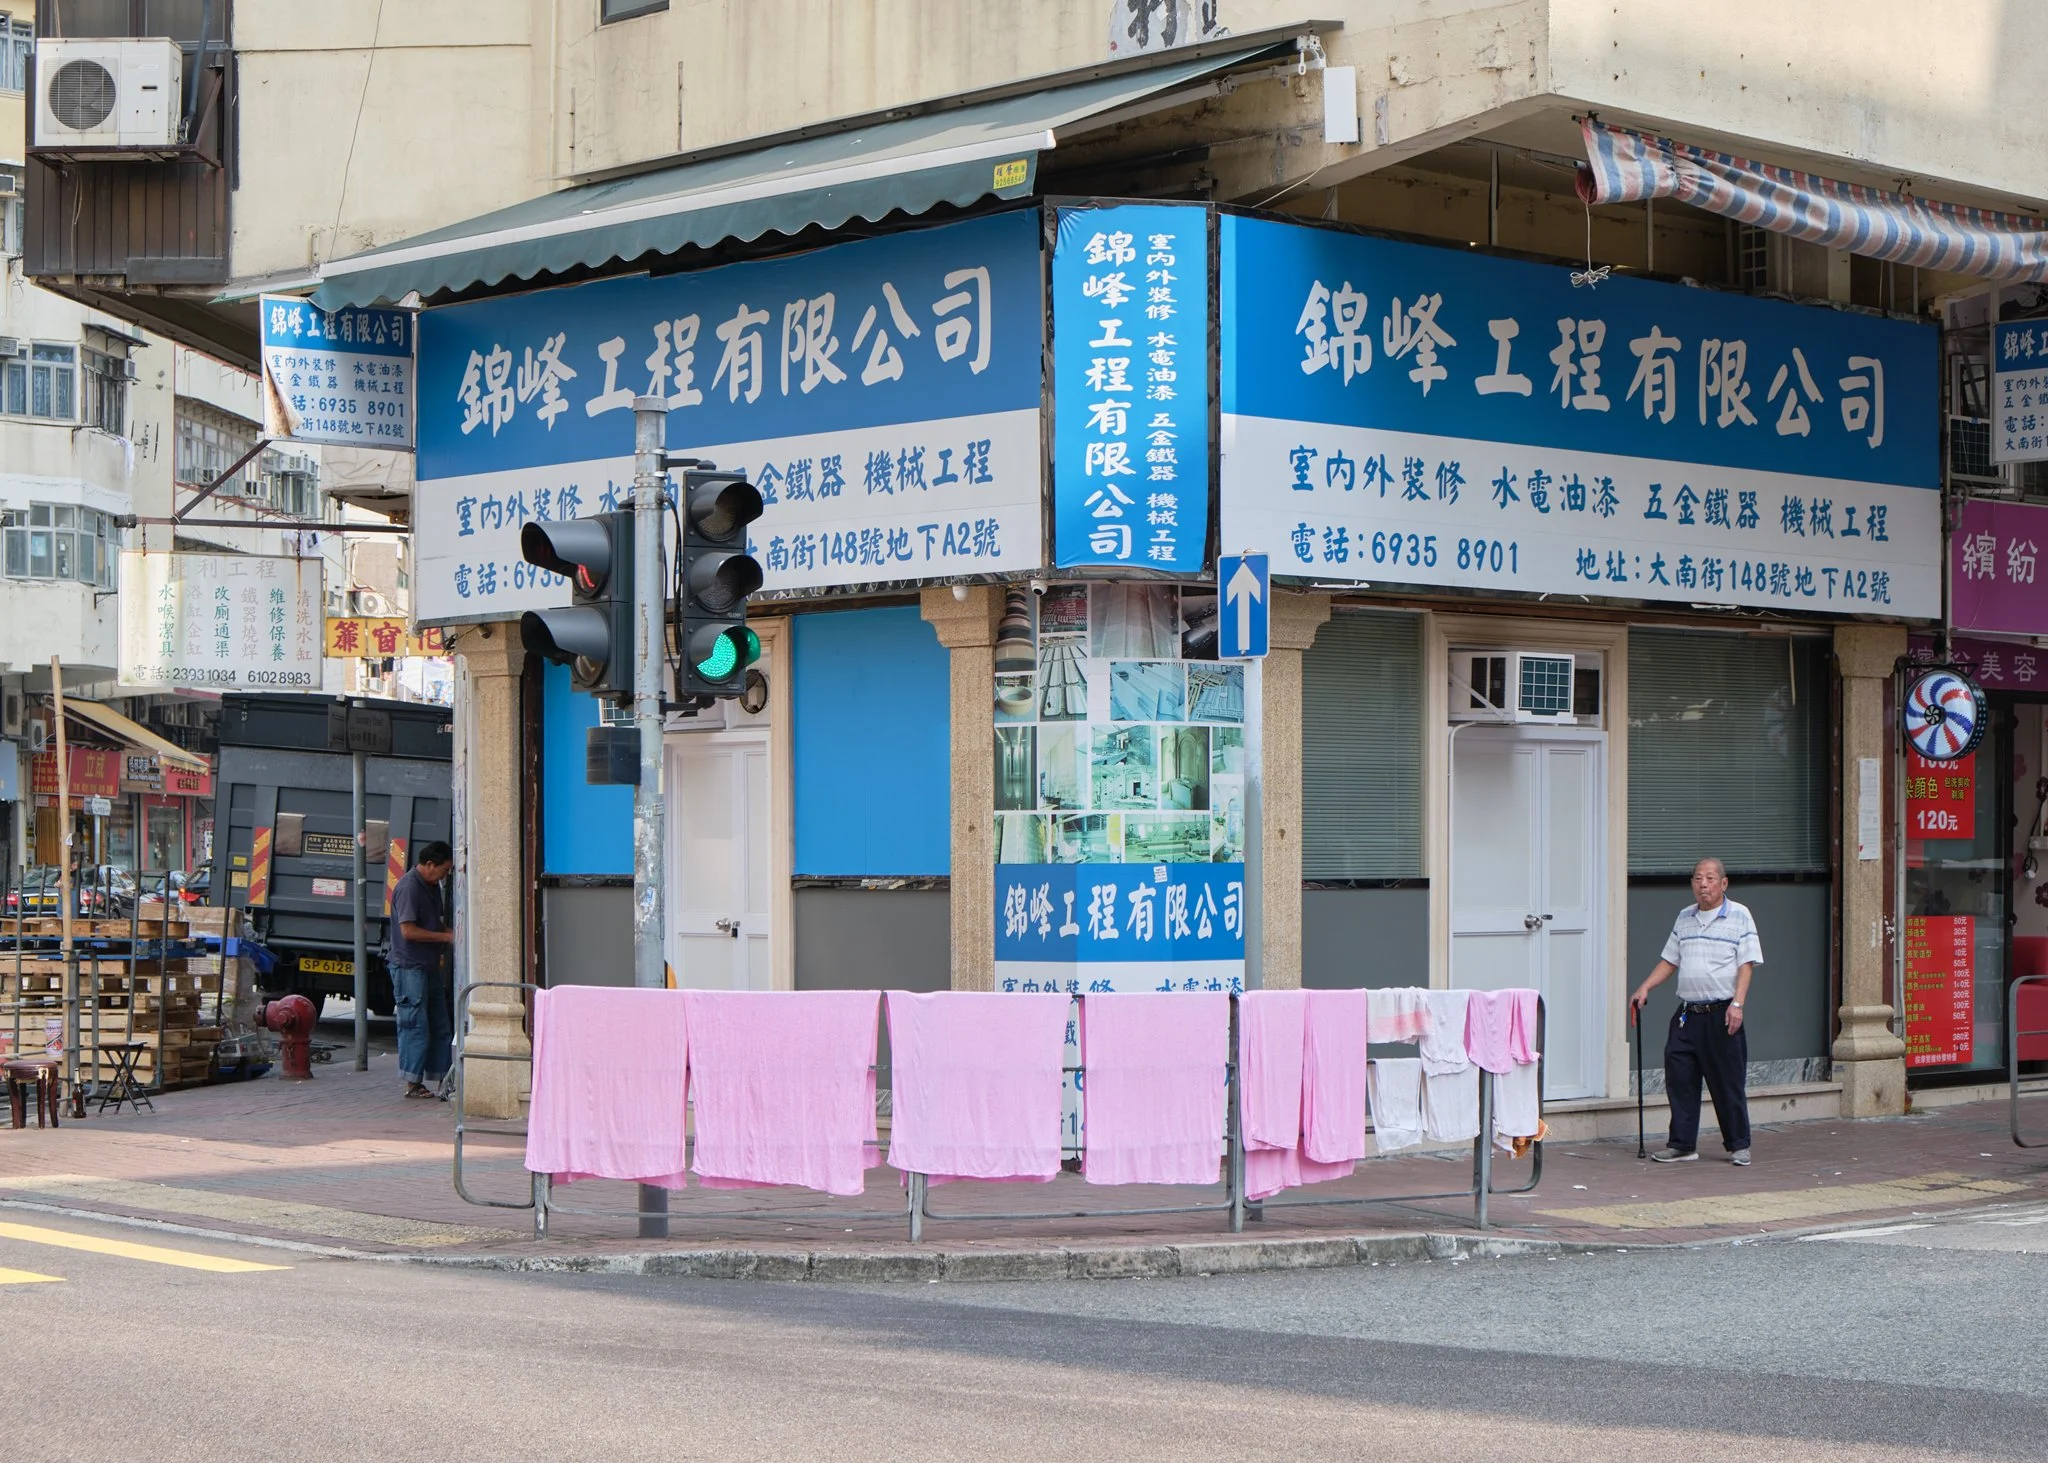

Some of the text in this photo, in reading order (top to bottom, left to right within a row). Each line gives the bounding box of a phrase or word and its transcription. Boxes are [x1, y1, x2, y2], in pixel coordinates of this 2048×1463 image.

[270, 304, 405, 347] 錦峰工程有限公司
[457, 266, 991, 438] 錦峰工程有限公司
[271, 354, 404, 378] 室內外裝修 水電油漆
[354, 378, 405, 395] 機械工程
[1082, 230, 1137, 560] 錦峰工程有限公司
[1145, 233, 1179, 562] 室內外裝修 水電油漆 五金鐵器 機械工程
[1295, 279, 1885, 449] 錦峰工程有限公司
[367, 400, 404, 418] 8901
[456, 483, 583, 537] 室內外裝修
[863, 438, 994, 496] 機械工程
[1289, 444, 1889, 542] 室內外裝修 水電油漆 五金鐵器 機械工程
[1291, 522, 1892, 604] 電話:6935 8901 地址:大南街148號地下A2號
[1961, 529, 2039, 584] 繽紛
[214, 586, 230, 659] 改廁通渠
[269, 588, 286, 662] 維修保養
[247, 670, 311, 685] 61028983
[1917, 810, 1958, 831] 120元
[1003, 881, 1243, 942] 錦峰工程有限公司
[304, 957, 353, 974] SP 6128
